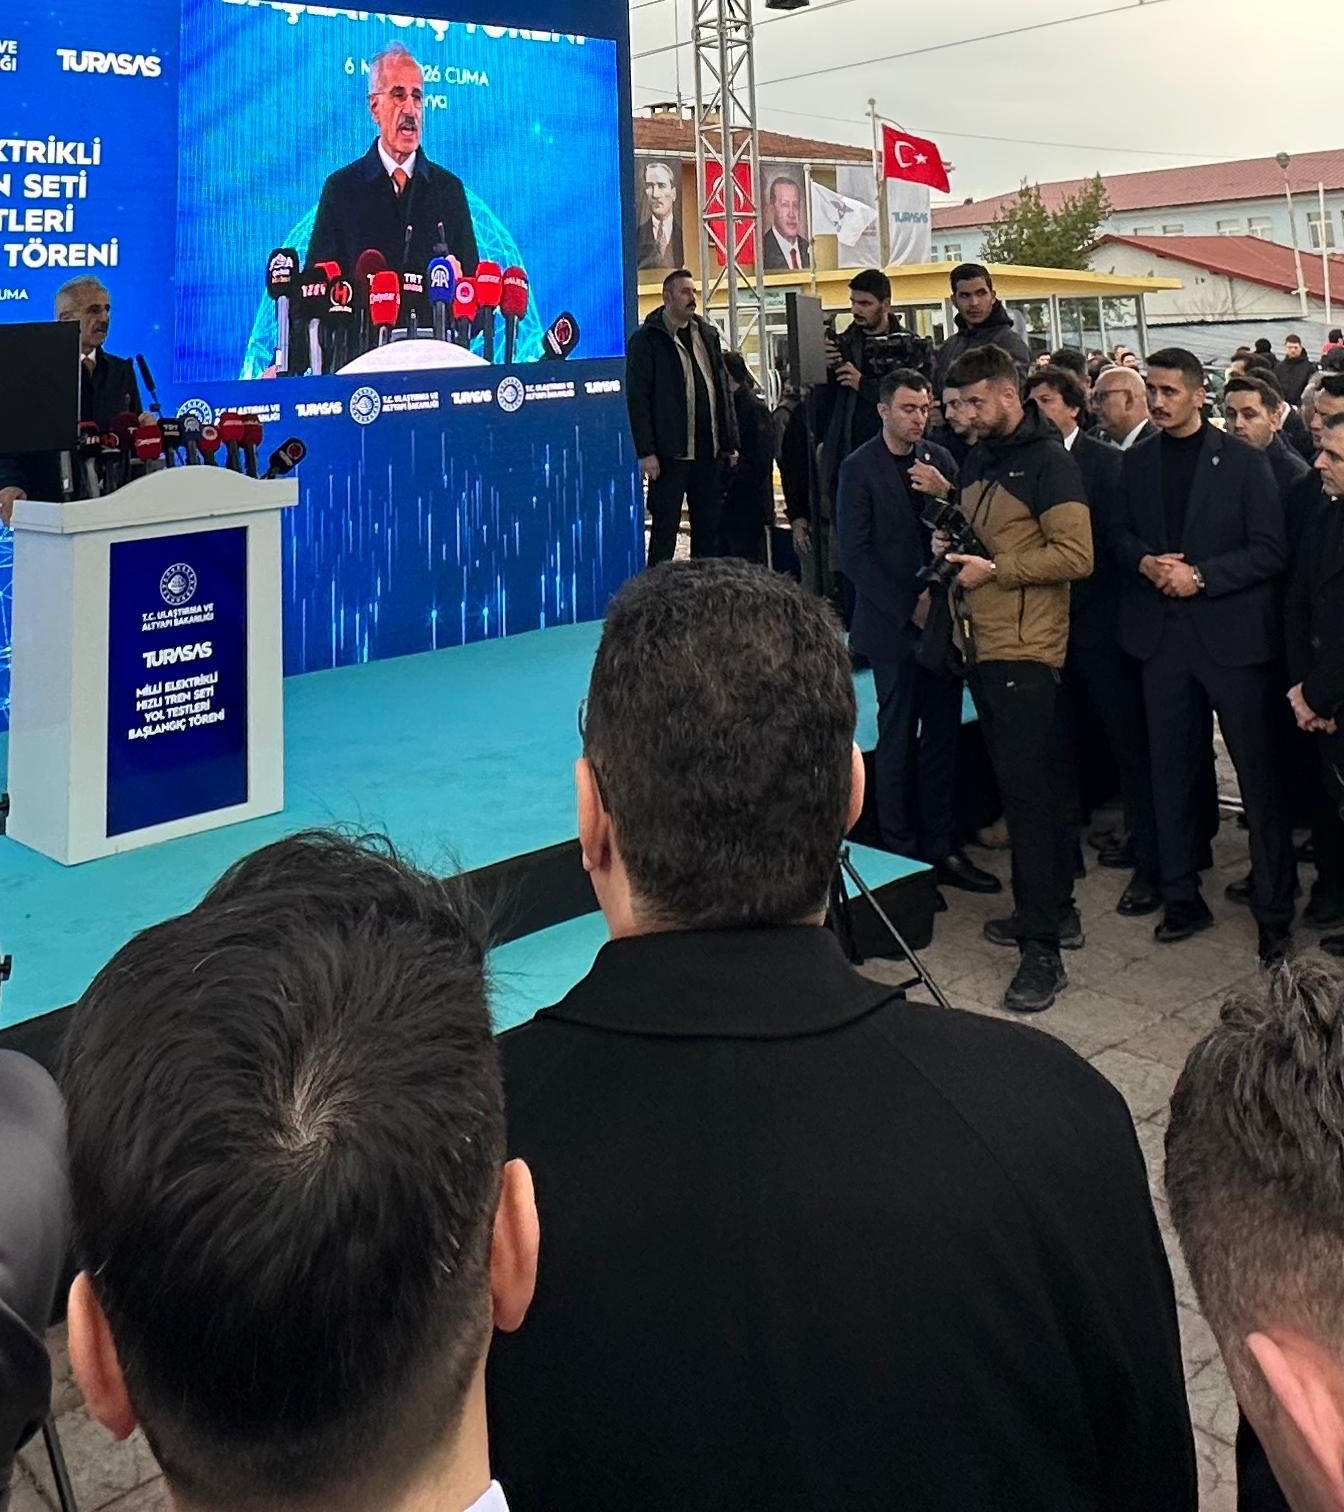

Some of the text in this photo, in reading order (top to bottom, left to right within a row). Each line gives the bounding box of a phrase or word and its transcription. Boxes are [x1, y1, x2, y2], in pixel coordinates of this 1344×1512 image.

[344, 57, 355, 75] 6
[444, 68, 490, 87] CUMA
[23, 169, 87, 199] SETİ
[4, 237, 119, 268] TÖRENİ
[136, 671, 218, 698] MİLLİ ELEKTRİKLİ
[136, 685, 214, 712] HIZLI TREN SETİ
[128, 708, 225, 739] BAŞLANGIÇ TÖRENİ
[144, 699, 211, 723] YOL TESTLERİ
